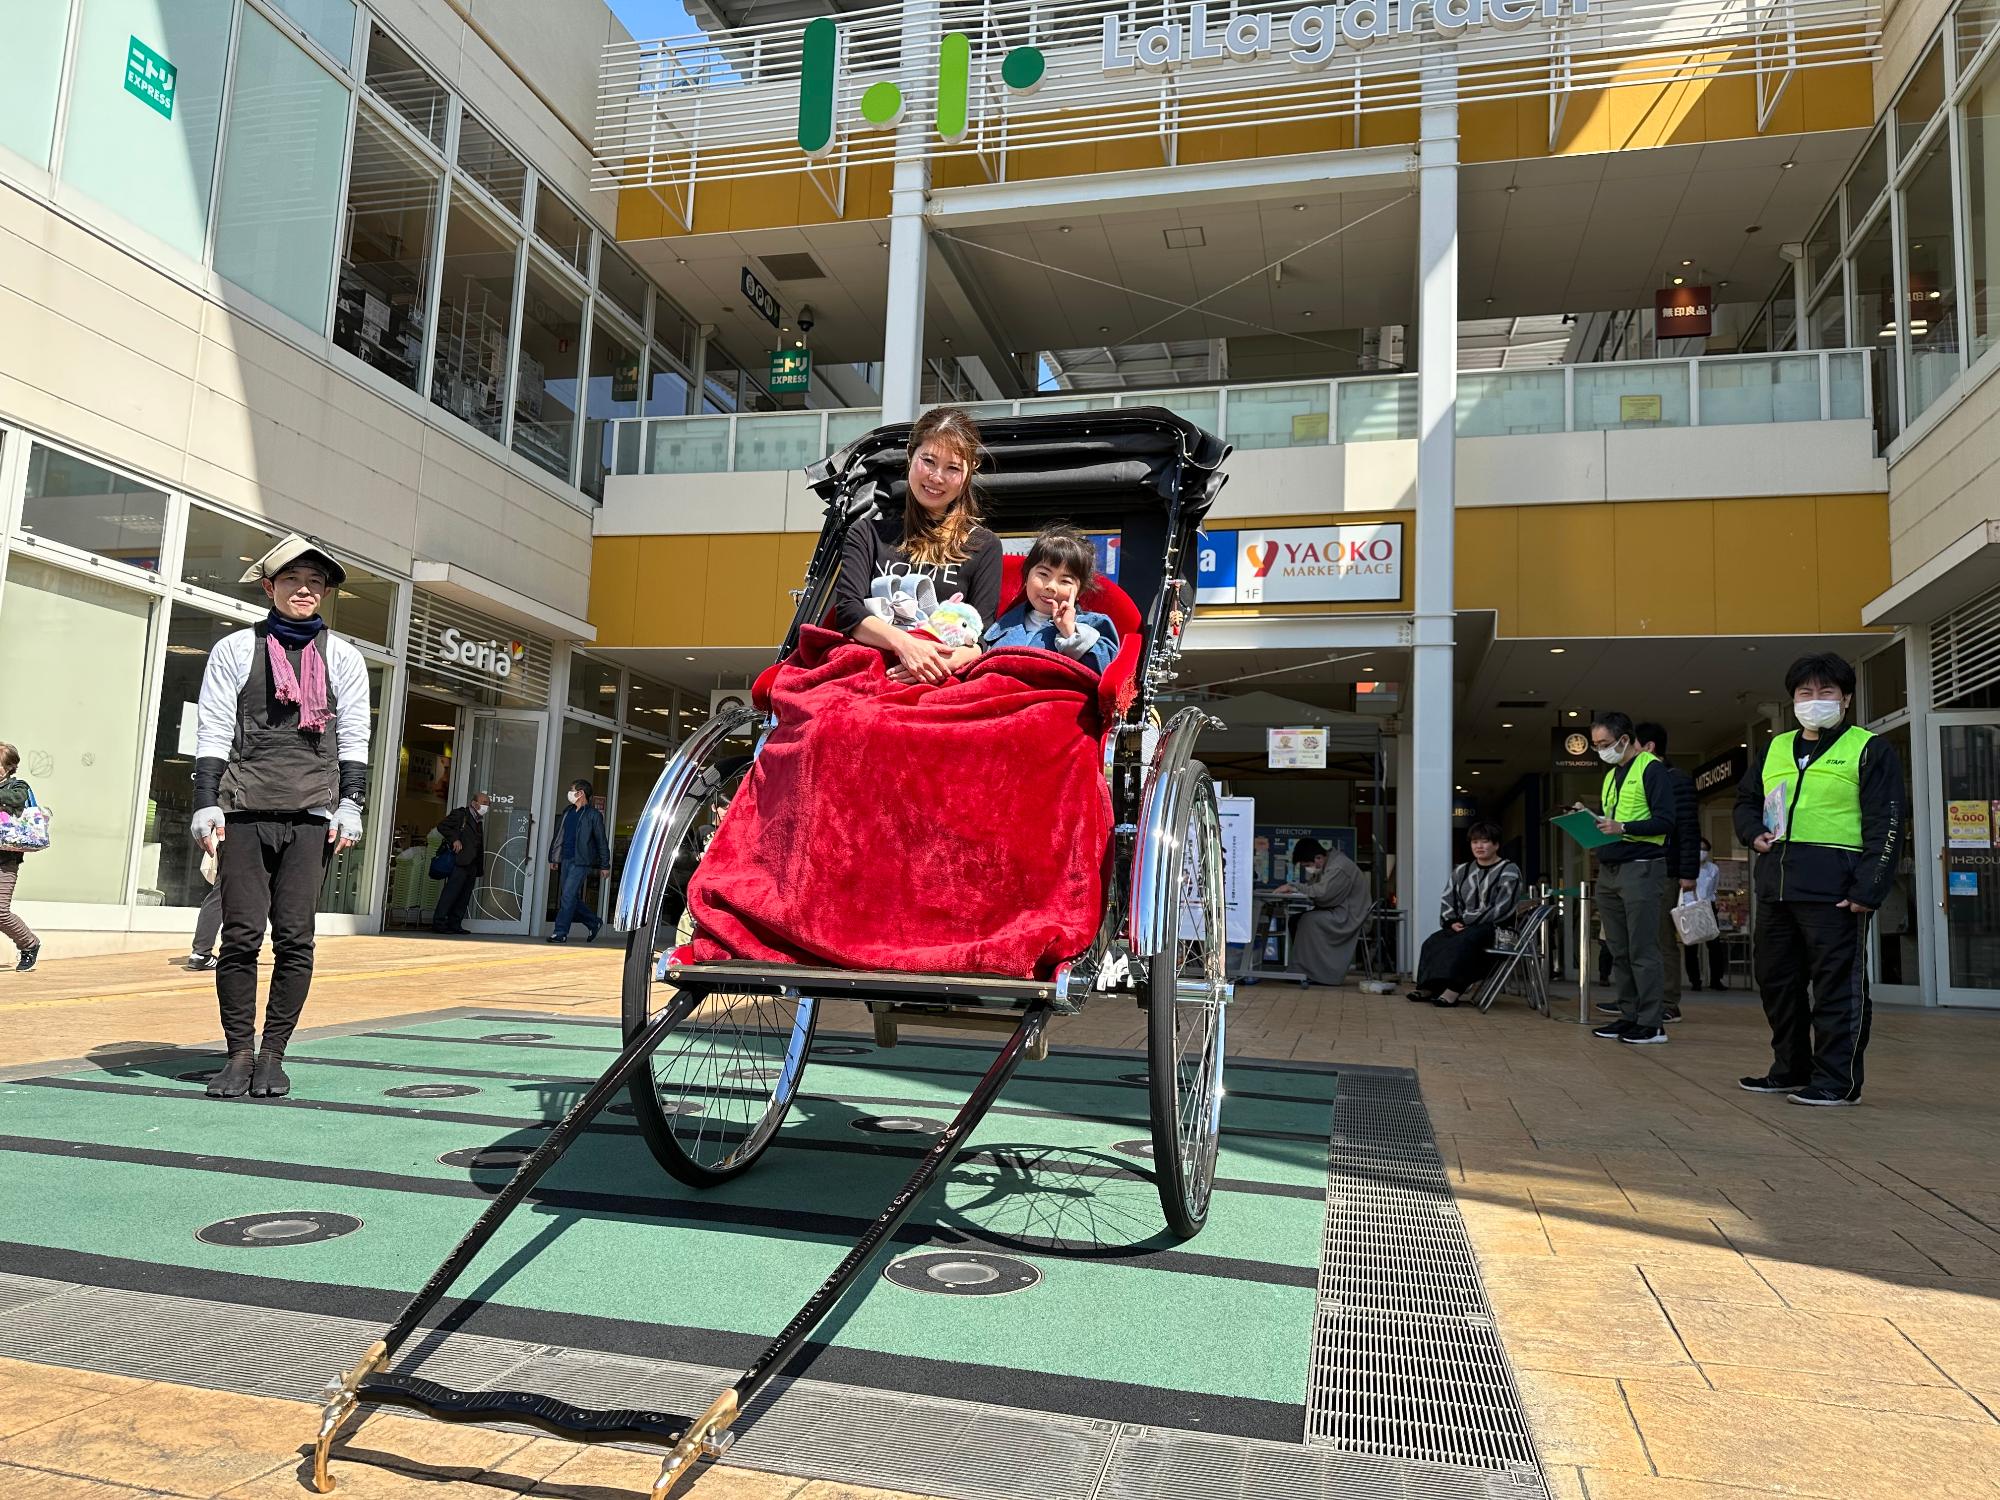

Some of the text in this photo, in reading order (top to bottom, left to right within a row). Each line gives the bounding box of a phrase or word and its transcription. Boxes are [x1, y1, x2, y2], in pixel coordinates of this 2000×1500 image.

[1102, 4, 1272, 71] LaLa
[129, 47, 174, 91] ニトリ
[127, 69, 171, 109] EXPRESS
[1662, 305, 1708, 318] 無印良品
[772, 357, 808, 373] ニトリ
[771, 375, 807, 385] EXPRESS
[1284, 539, 1393, 564] YAOKO
[1282, 563, 1394, 577] MARKETPLACE
[1245, 588, 1260, 599] 1F
[440, 628, 511, 677] Seria
[1695, 760, 1732, 791] MITSUKOSHI
